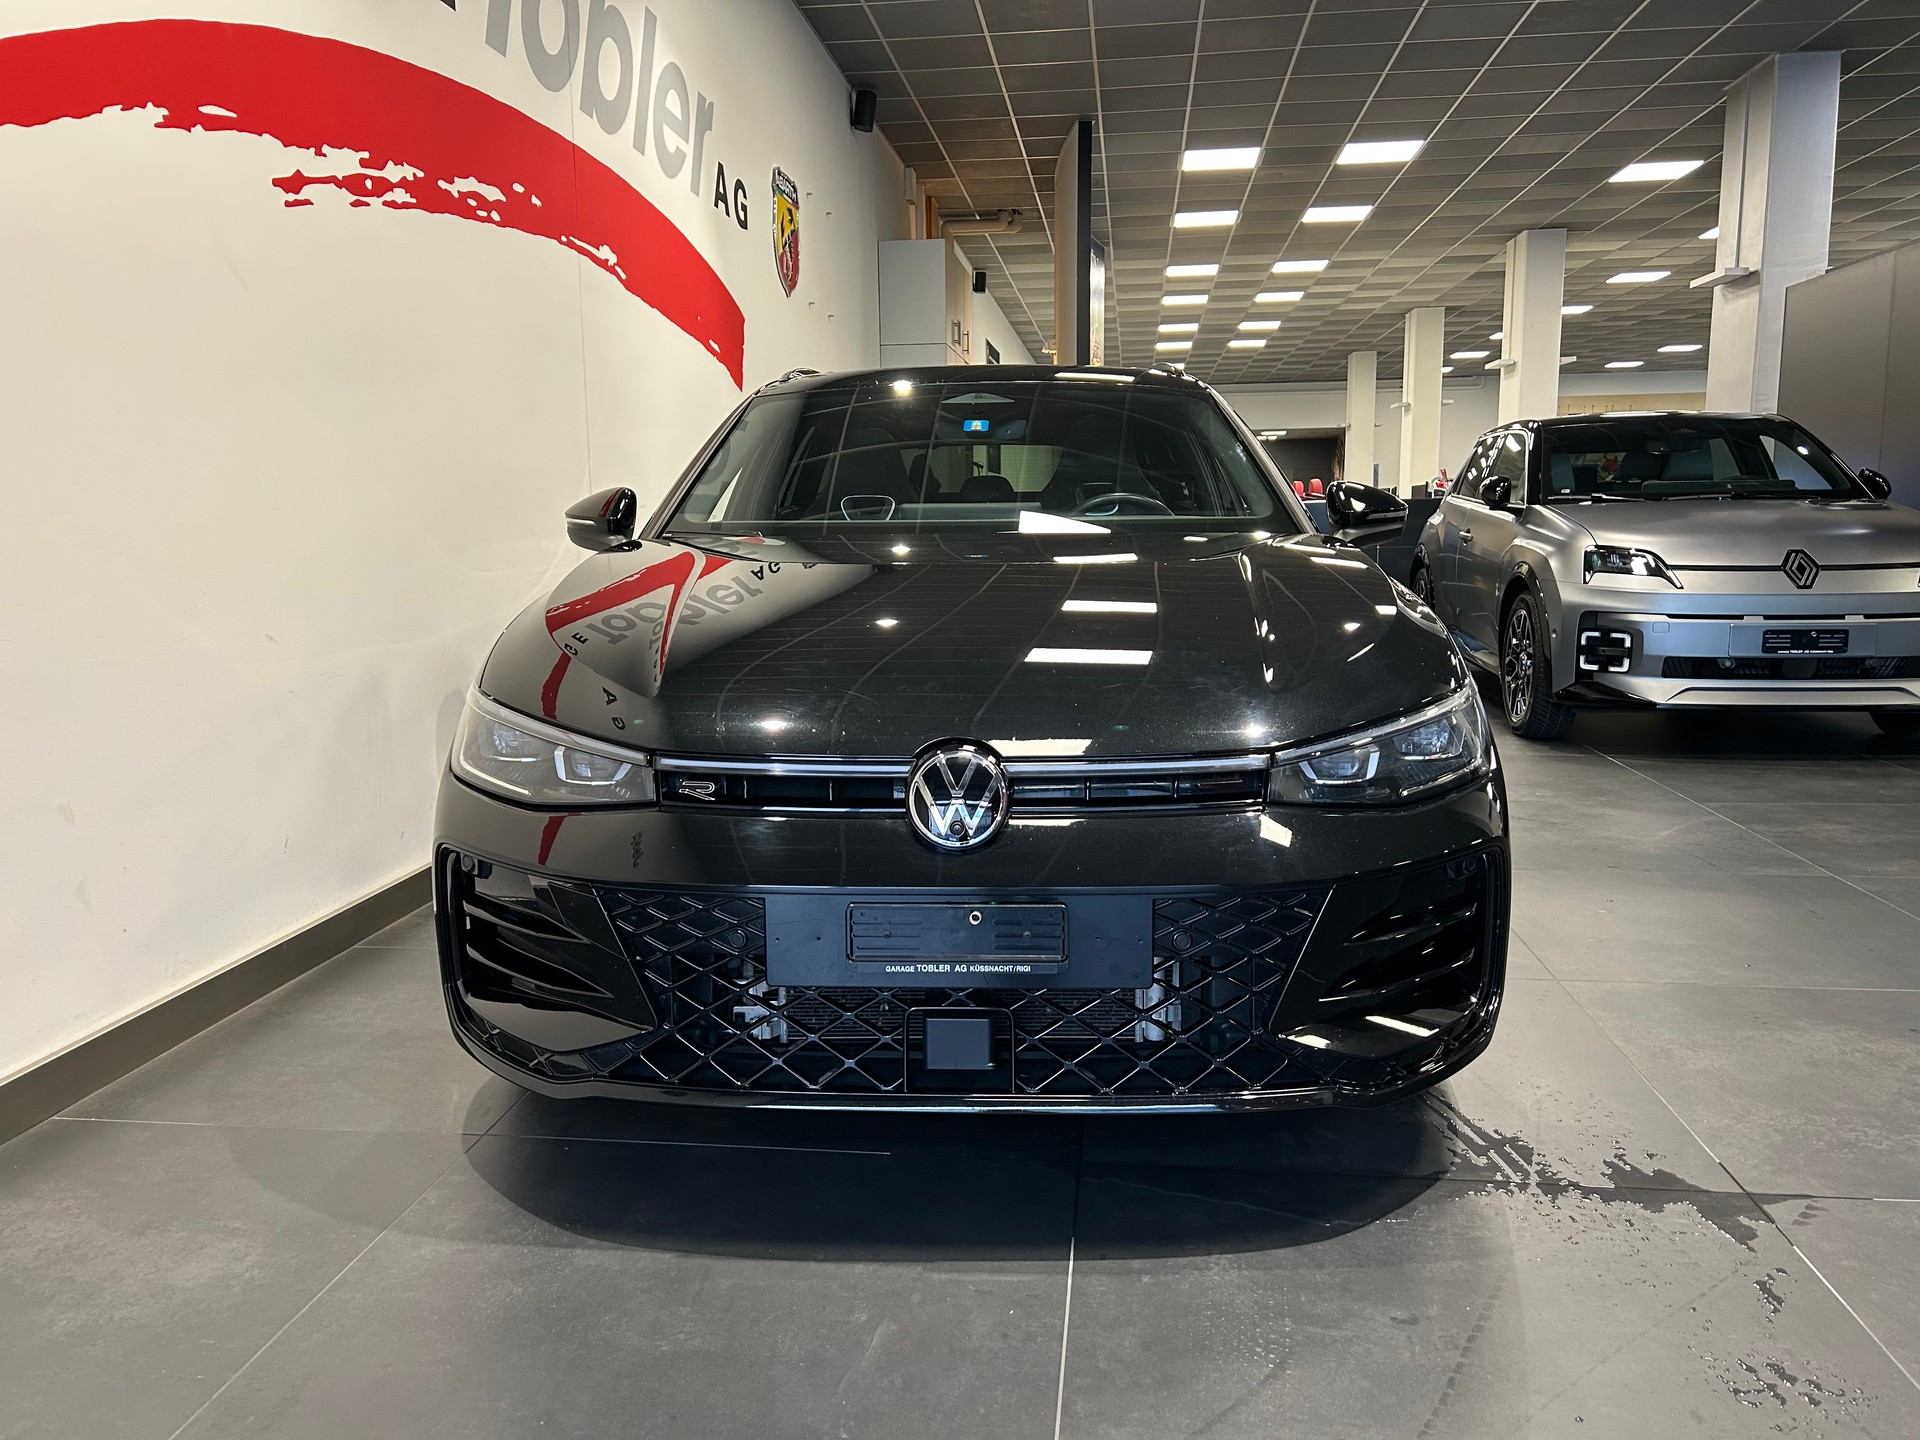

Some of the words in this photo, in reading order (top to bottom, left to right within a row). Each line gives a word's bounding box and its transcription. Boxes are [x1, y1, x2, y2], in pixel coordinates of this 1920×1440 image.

[714, 161, 748, 230] AG
[911, 752, 1004, 842] VW
[885, 965, 915, 973] GARAGE
[916, 964, 951, 973] TOBLER
[954, 964, 968, 973] AG
